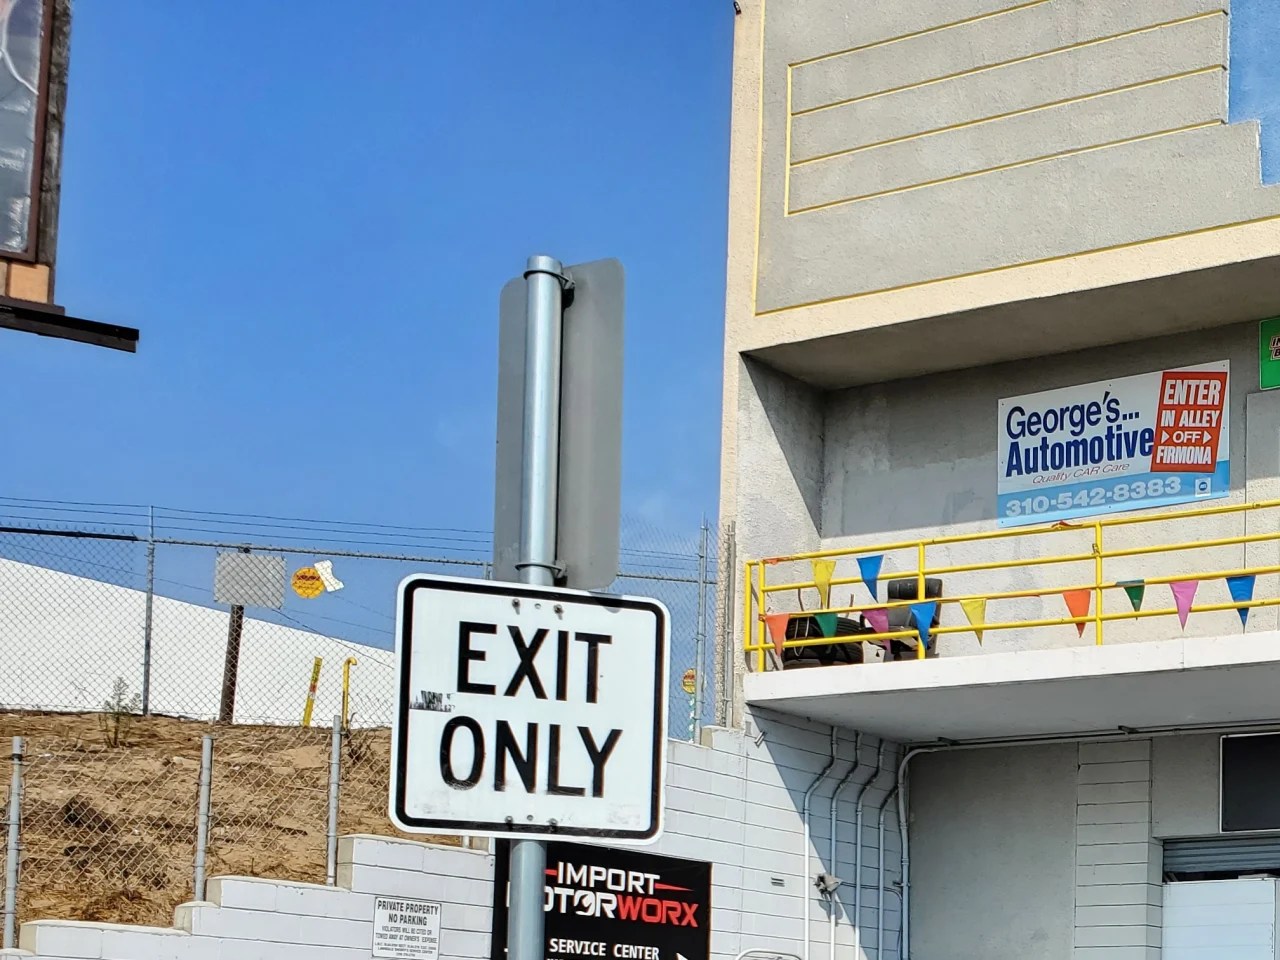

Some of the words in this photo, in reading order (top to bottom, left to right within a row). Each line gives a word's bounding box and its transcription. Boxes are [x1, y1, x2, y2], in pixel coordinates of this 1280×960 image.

[1163, 379, 1222, 406] ENTER
[1161, 410, 1175, 427] IN
[1179, 409, 1221, 427] ALLEY
[1172, 430, 1202, 443] OFF
[1006, 424, 1154, 477] Automotive
[1156, 446, 1212, 465] FIRMONA
[1032, 471, 1071, 485] Quality
[1073, 467, 1099, 477] CAR
[1102, 463, 1130, 473] Care
[457, 621, 612, 704] EXIT
[439, 715, 623, 798] ONLY
[557, 861, 660, 895] IMPORT
[378, 900, 404, 911] PRIVATE
[406, 903, 439, 915] PROPERTY
[389, 913, 398, 923] NO
[400, 914, 427, 926] PARKING
[549, 937, 606, 957] SERVICE
[613, 943, 660, 960] CENTER
